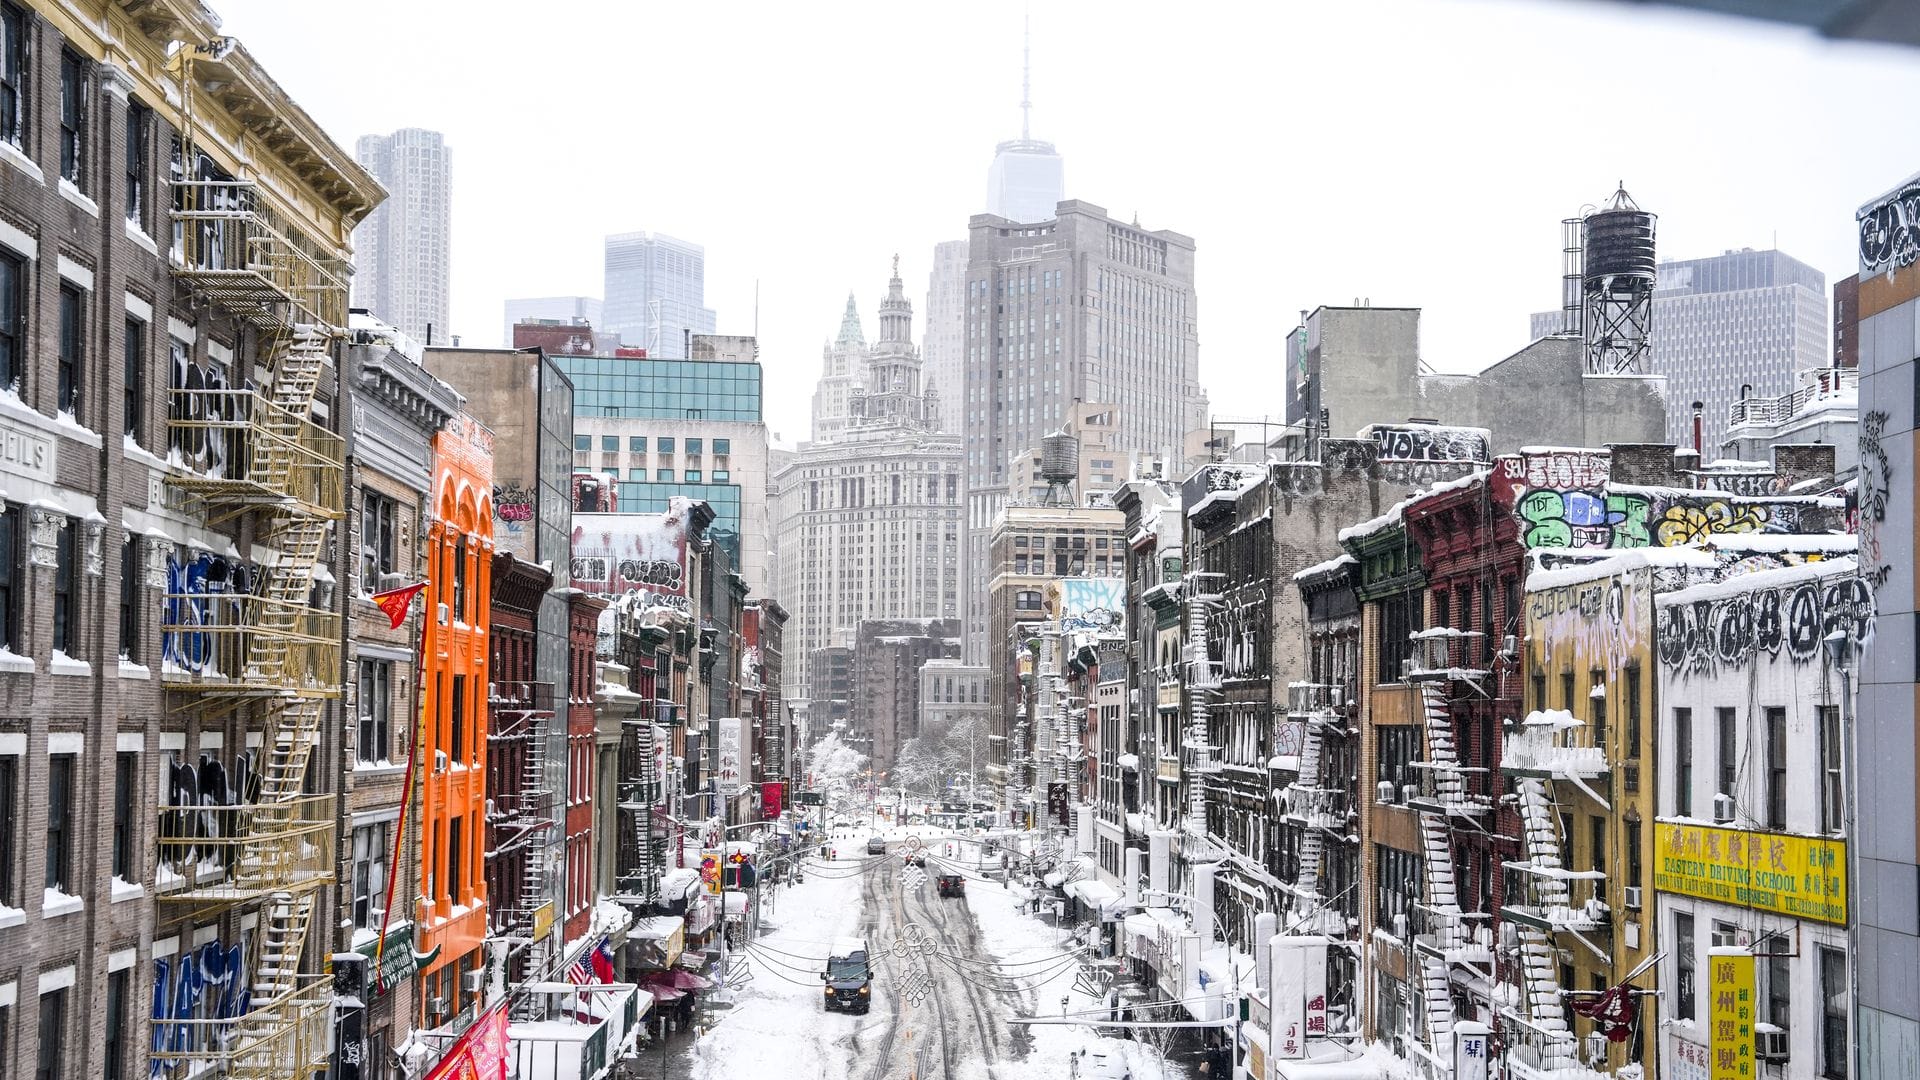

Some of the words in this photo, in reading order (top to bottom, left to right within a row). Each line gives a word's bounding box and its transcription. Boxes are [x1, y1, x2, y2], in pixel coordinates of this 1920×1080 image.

[1664, 857, 1705, 877] EASTERN
[1710, 863, 1751, 884] DRIVING
[1755, 870, 1797, 893] SCHOOL
[1717, 962, 1736, 1080] 廣州駕駛
